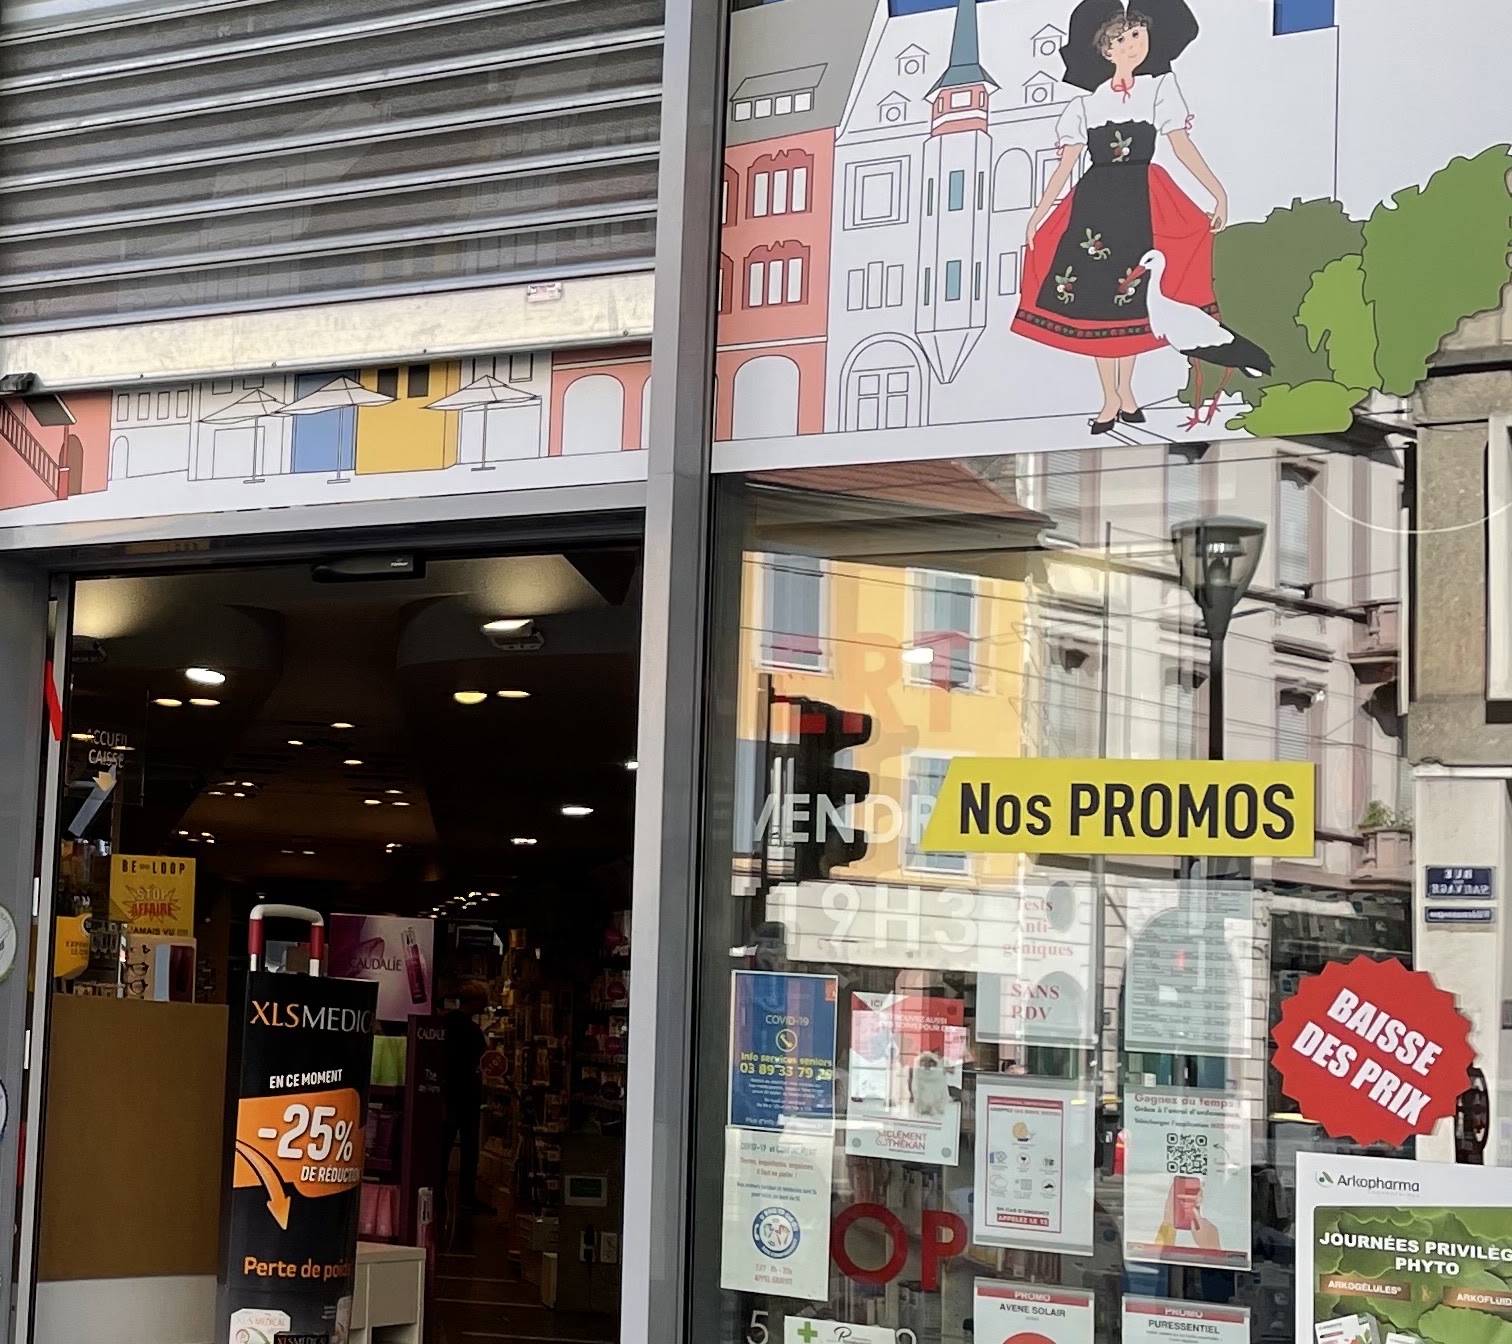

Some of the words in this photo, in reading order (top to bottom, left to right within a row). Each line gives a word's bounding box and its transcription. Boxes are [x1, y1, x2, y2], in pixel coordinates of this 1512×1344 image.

[88, 749, 125, 769] CAISSE
[960, 783, 1052, 837] Nos
[1070, 782, 1296, 841] PROMOS
[121, 859, 136, 874] BE
[152, 862, 186, 876] LOOP
[137, 888, 169, 901] STOP
[131, 901, 173, 917] AFFAIRE
[1016, 897, 1053, 913] Tests
[1010, 983, 1060, 1000] SANS
[765, 1014, 810, 1026] COVID-19
[1010, 1005, 1053, 1022] RDV
[1327, 988, 1443, 1077] BAISSE
[740, 1062, 755, 1074] 03
[1292, 1021, 1352, 1080] DES
[1356, 1055, 1433, 1126] PRIX
[269, 1074, 285, 1089] EN
[285, 1073, 300, 1087] CE
[301, 1069, 343, 1086] MOMENT
[1134, 1093, 1178, 1106] Gagnez
[257, 1103, 353, 1162] -25%
[300, 1166, 317, 1182] DE
[1337, 1174, 1419, 1192] Arkopharma
[1319, 1232, 1419, 1253] JOURNÉES
[244, 1256, 298, 1278] Perte
[300, 1258, 321, 1278] de
[1395, 1257, 1460, 1275] PHYTO
[1014, 1291, 1051, 1302] PROMO
[1000, 1304, 1030, 1314] AVENE
[1032, 1307, 1066, 1317] SOLAIR
[1165, 1308, 1204, 1319] PROMO
[1149, 1319, 1220, 1334] PURESSENTIEL
